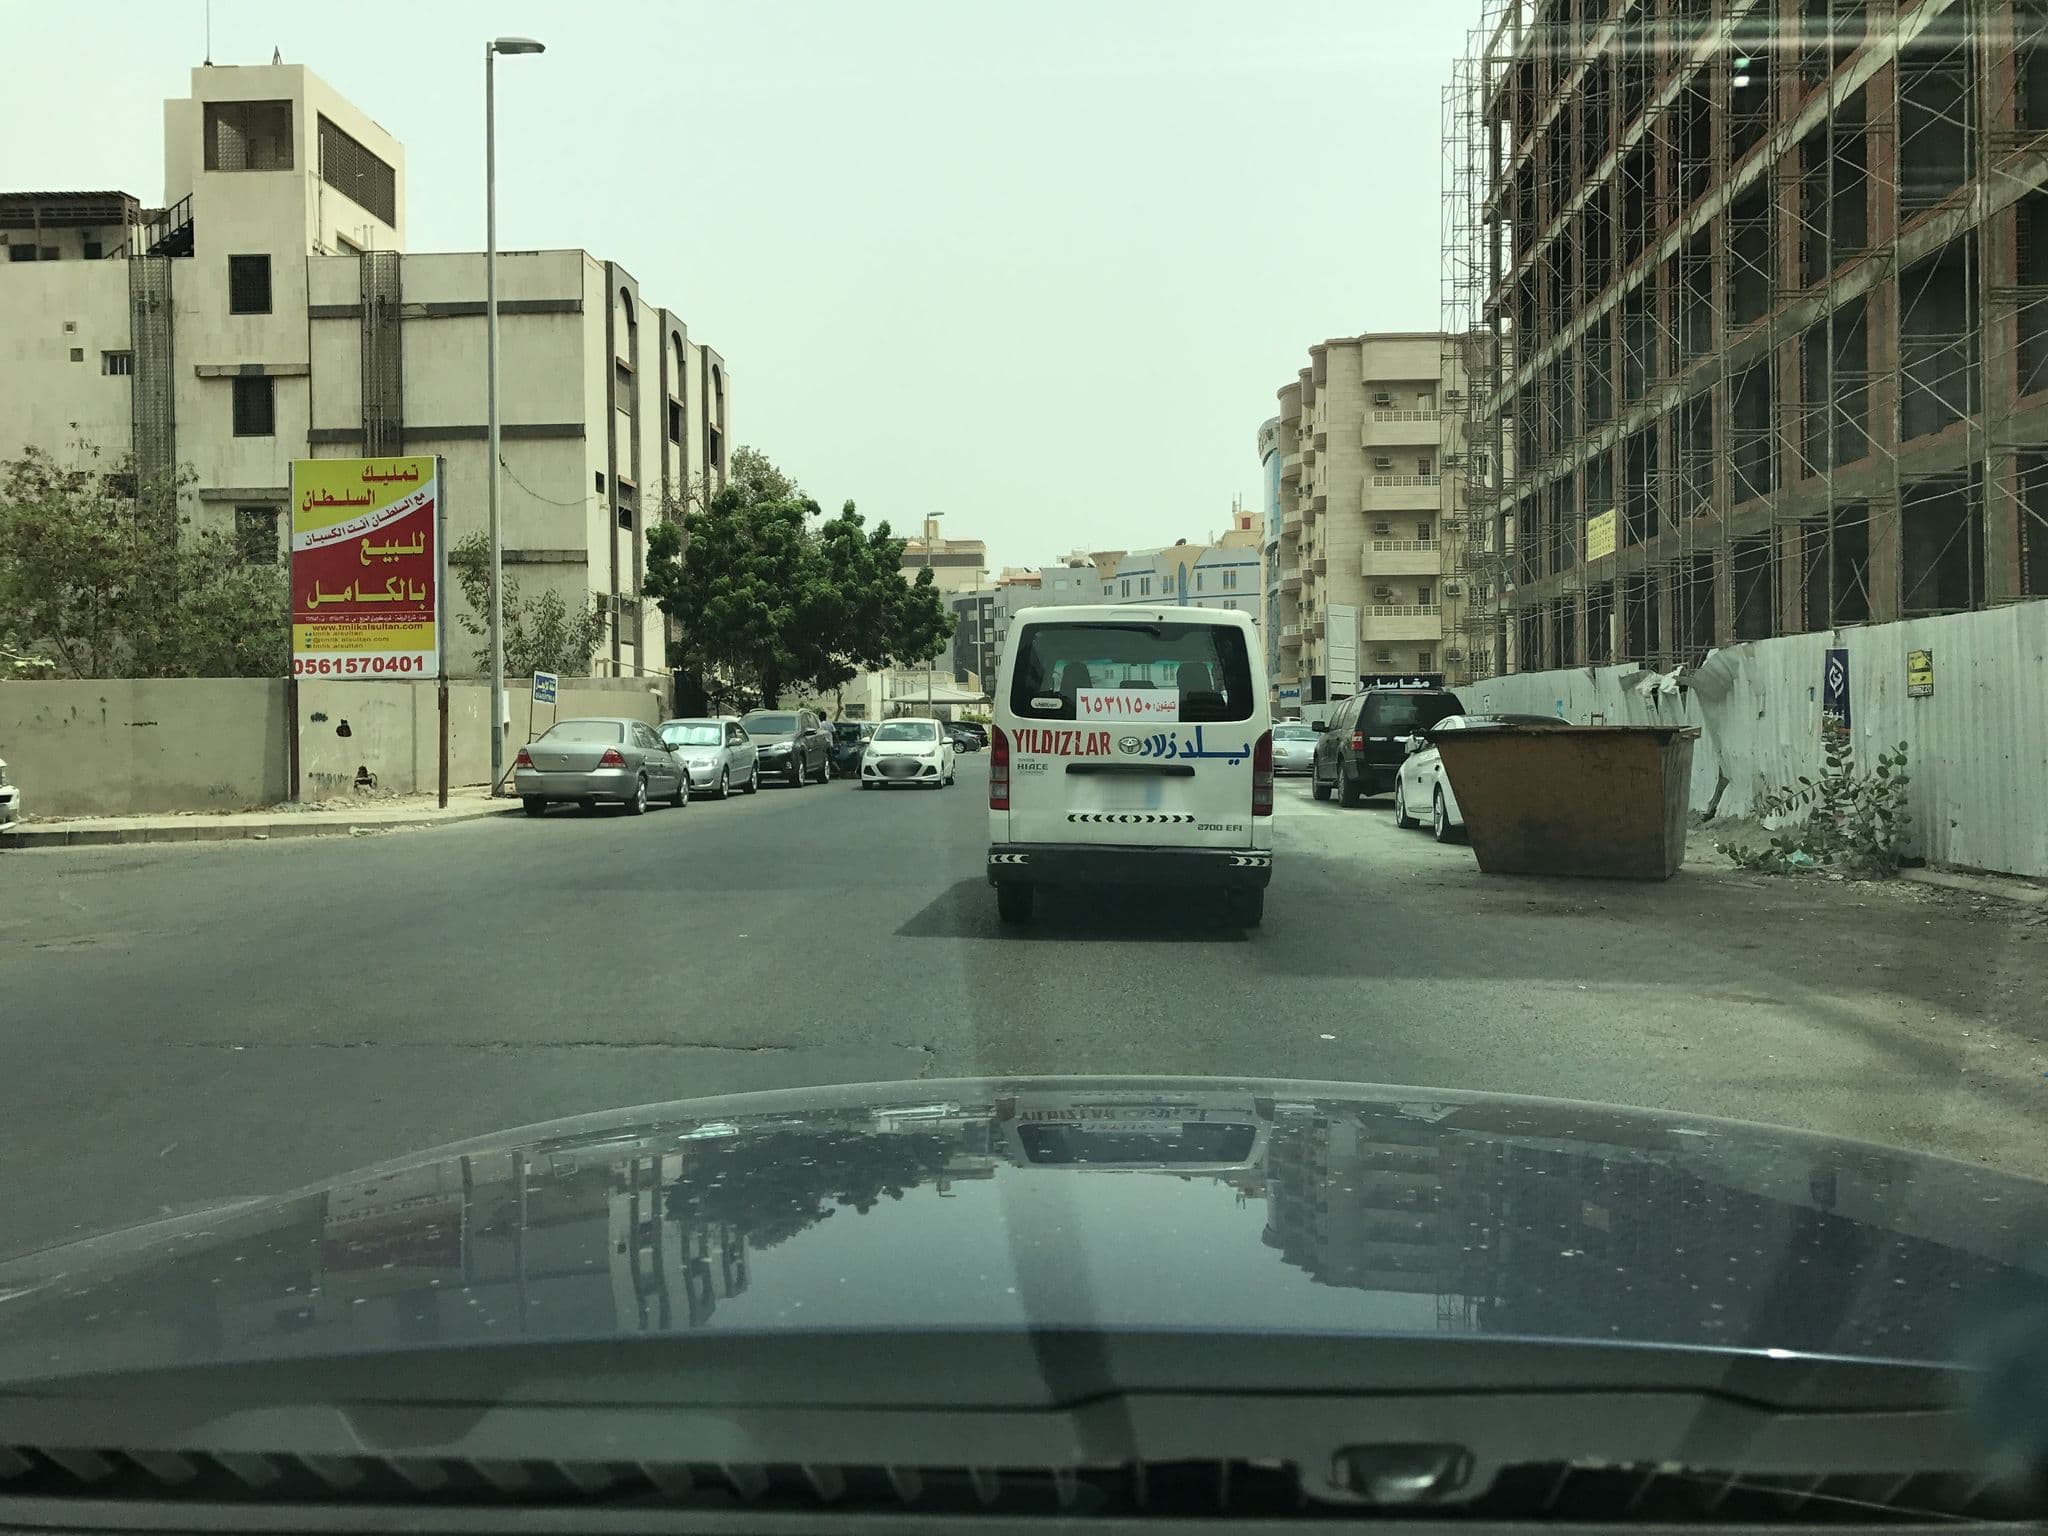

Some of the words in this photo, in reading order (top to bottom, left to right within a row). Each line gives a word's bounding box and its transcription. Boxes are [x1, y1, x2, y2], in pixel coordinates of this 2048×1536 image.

[361, 464, 419, 486] تمليك
[302, 488, 376, 512] السلطان
[413, 492, 426, 506] مع
[372, 498, 414, 527] السلطان
[360, 530, 426, 566] للبيع
[306, 576, 427, 610] بالكامل
[293, 655, 424, 675] 0561570401
[1012, 729, 1112, 756] YILDIZLAR
[1017, 763, 1049, 771] HIACE
[1197, 823, 1223, 831] 2700
[1225, 824, 1243, 832] EFI
